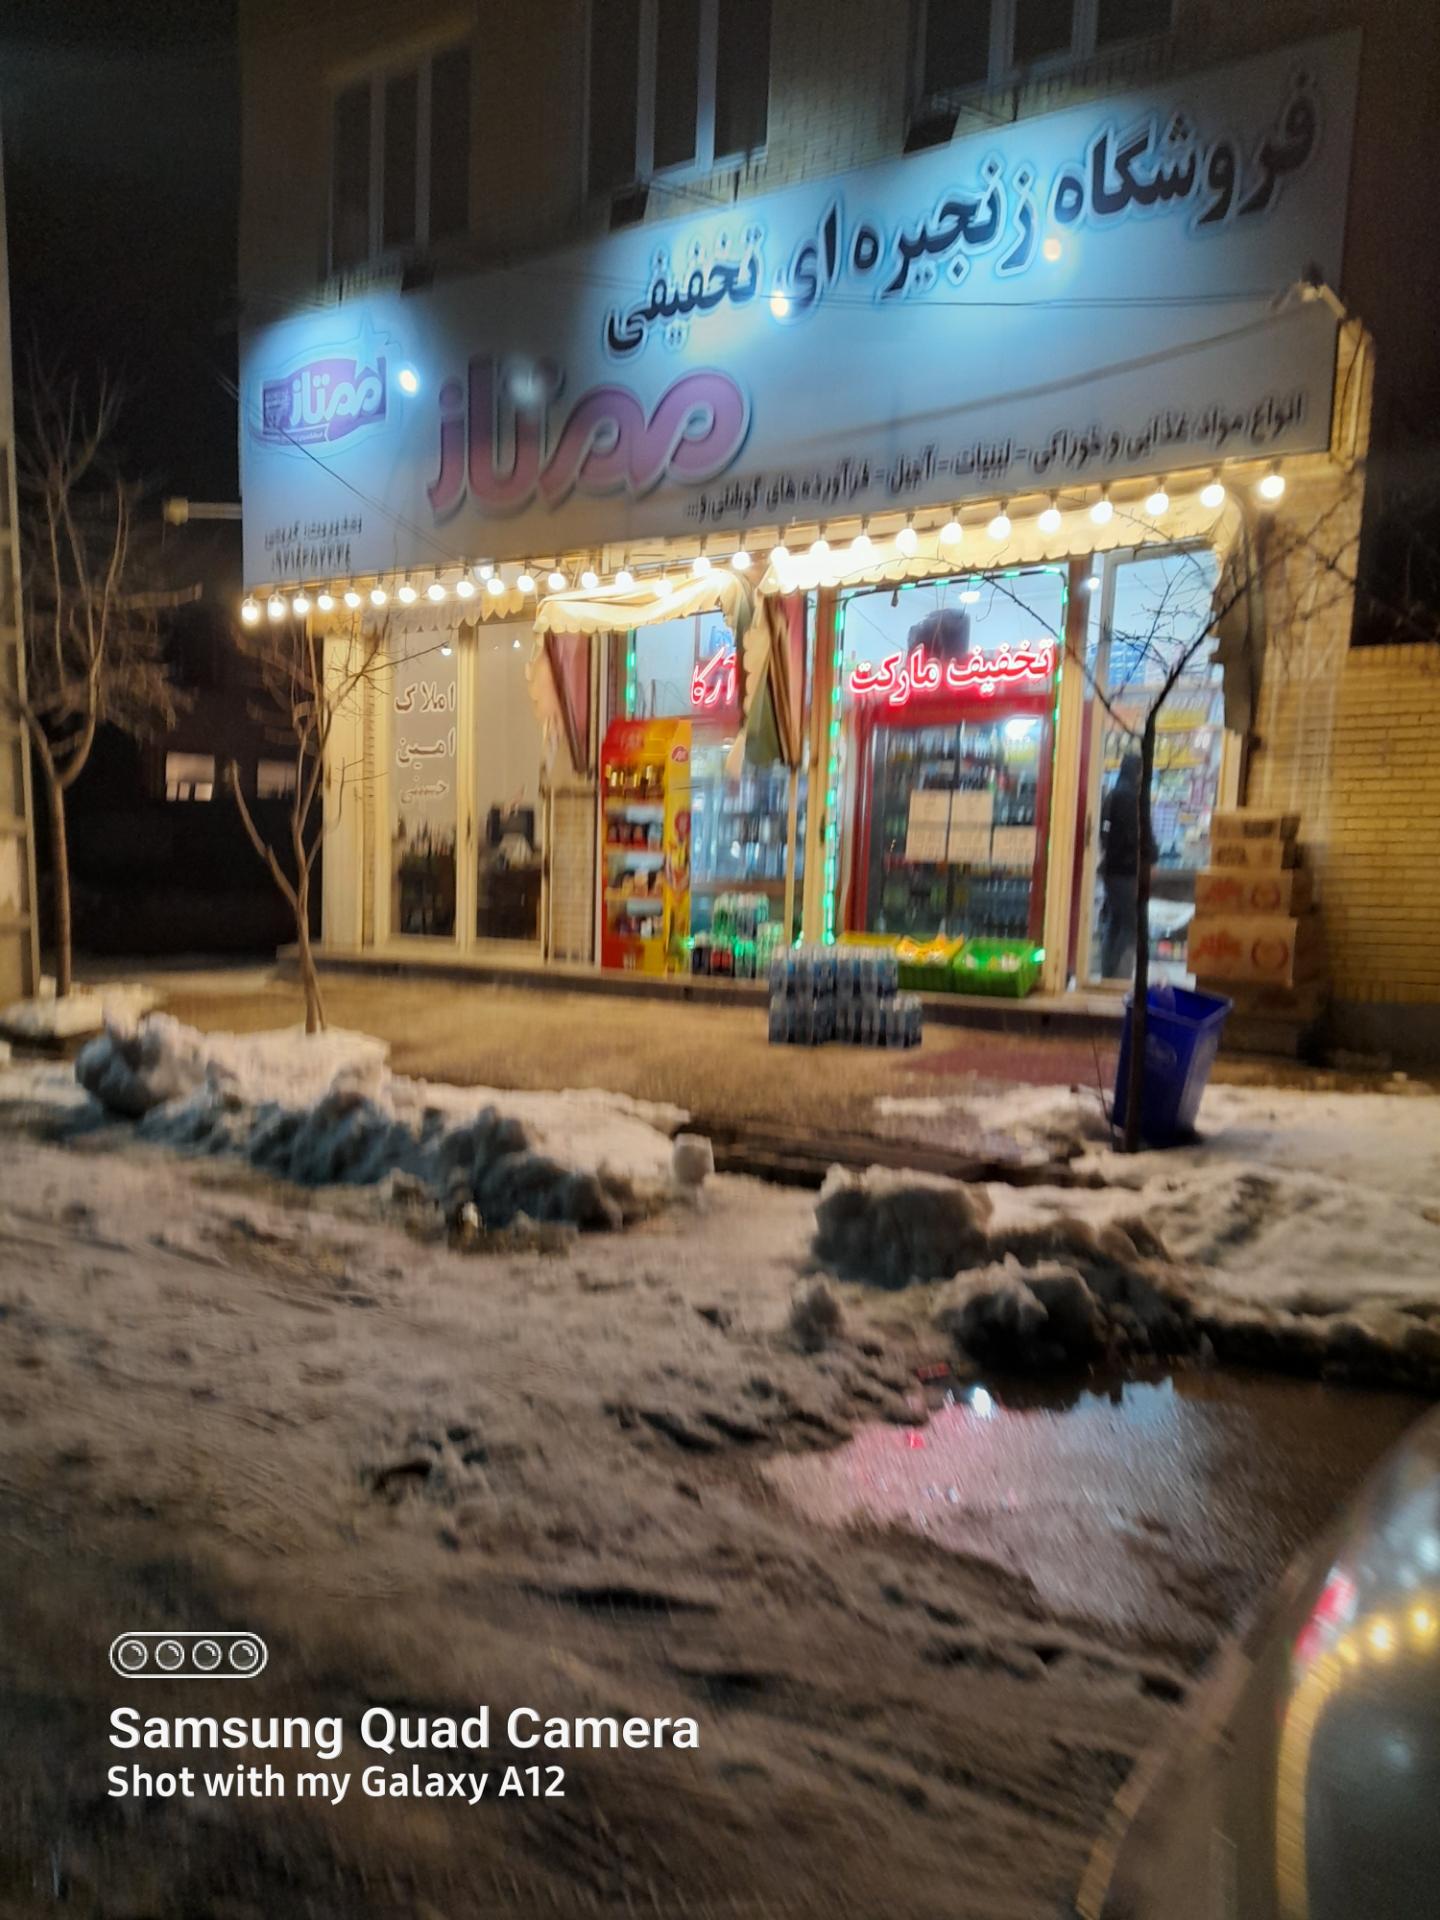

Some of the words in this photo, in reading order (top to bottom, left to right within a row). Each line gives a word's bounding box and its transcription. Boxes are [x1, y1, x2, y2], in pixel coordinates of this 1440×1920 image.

[1048, 72, 1321, 228] فروشگاه
[852, 158, 1034, 298] زنجیره
[603, 224, 764, 358] تخفیفی
[289, 371, 384, 426] ممتاز
[427, 352, 752, 526] ممتاز
[394, 680, 457, 713] املاک
[848, 643, 941, 706] مارکت
[947, 638, 1056, 695] تخفیف
[396, 727, 457, 769] امین
